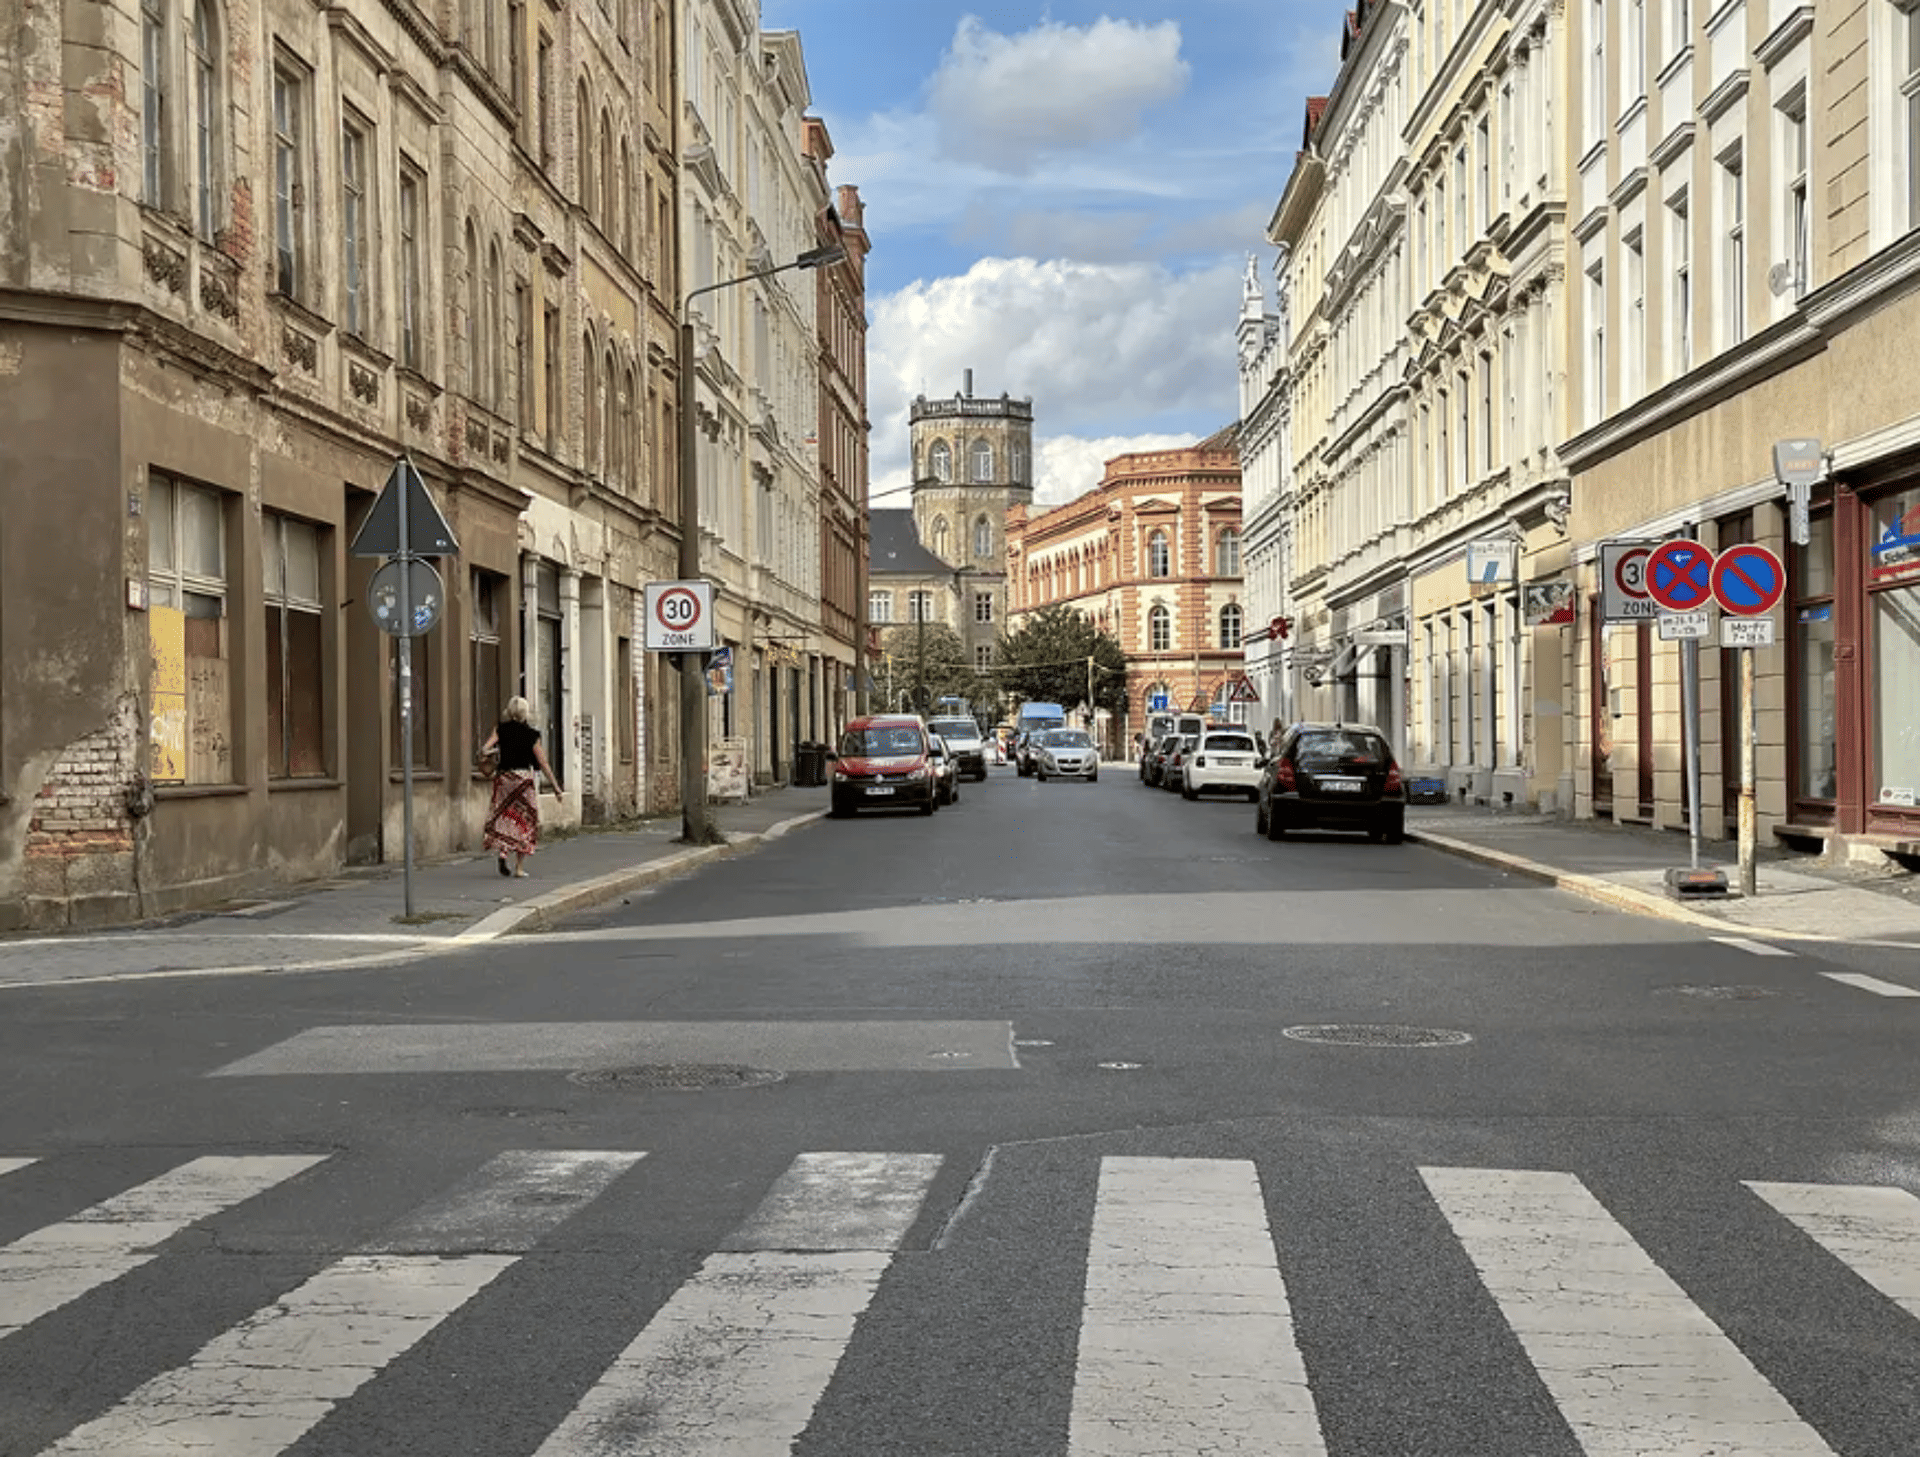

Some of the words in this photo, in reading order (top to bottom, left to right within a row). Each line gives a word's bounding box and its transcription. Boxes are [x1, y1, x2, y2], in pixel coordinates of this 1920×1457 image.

[1625, 563, 1647, 585] 3
[666, 598, 692, 620] 30
[1622, 601, 1661, 615] ZONE
[662, 633, 696, 645] ZONE
